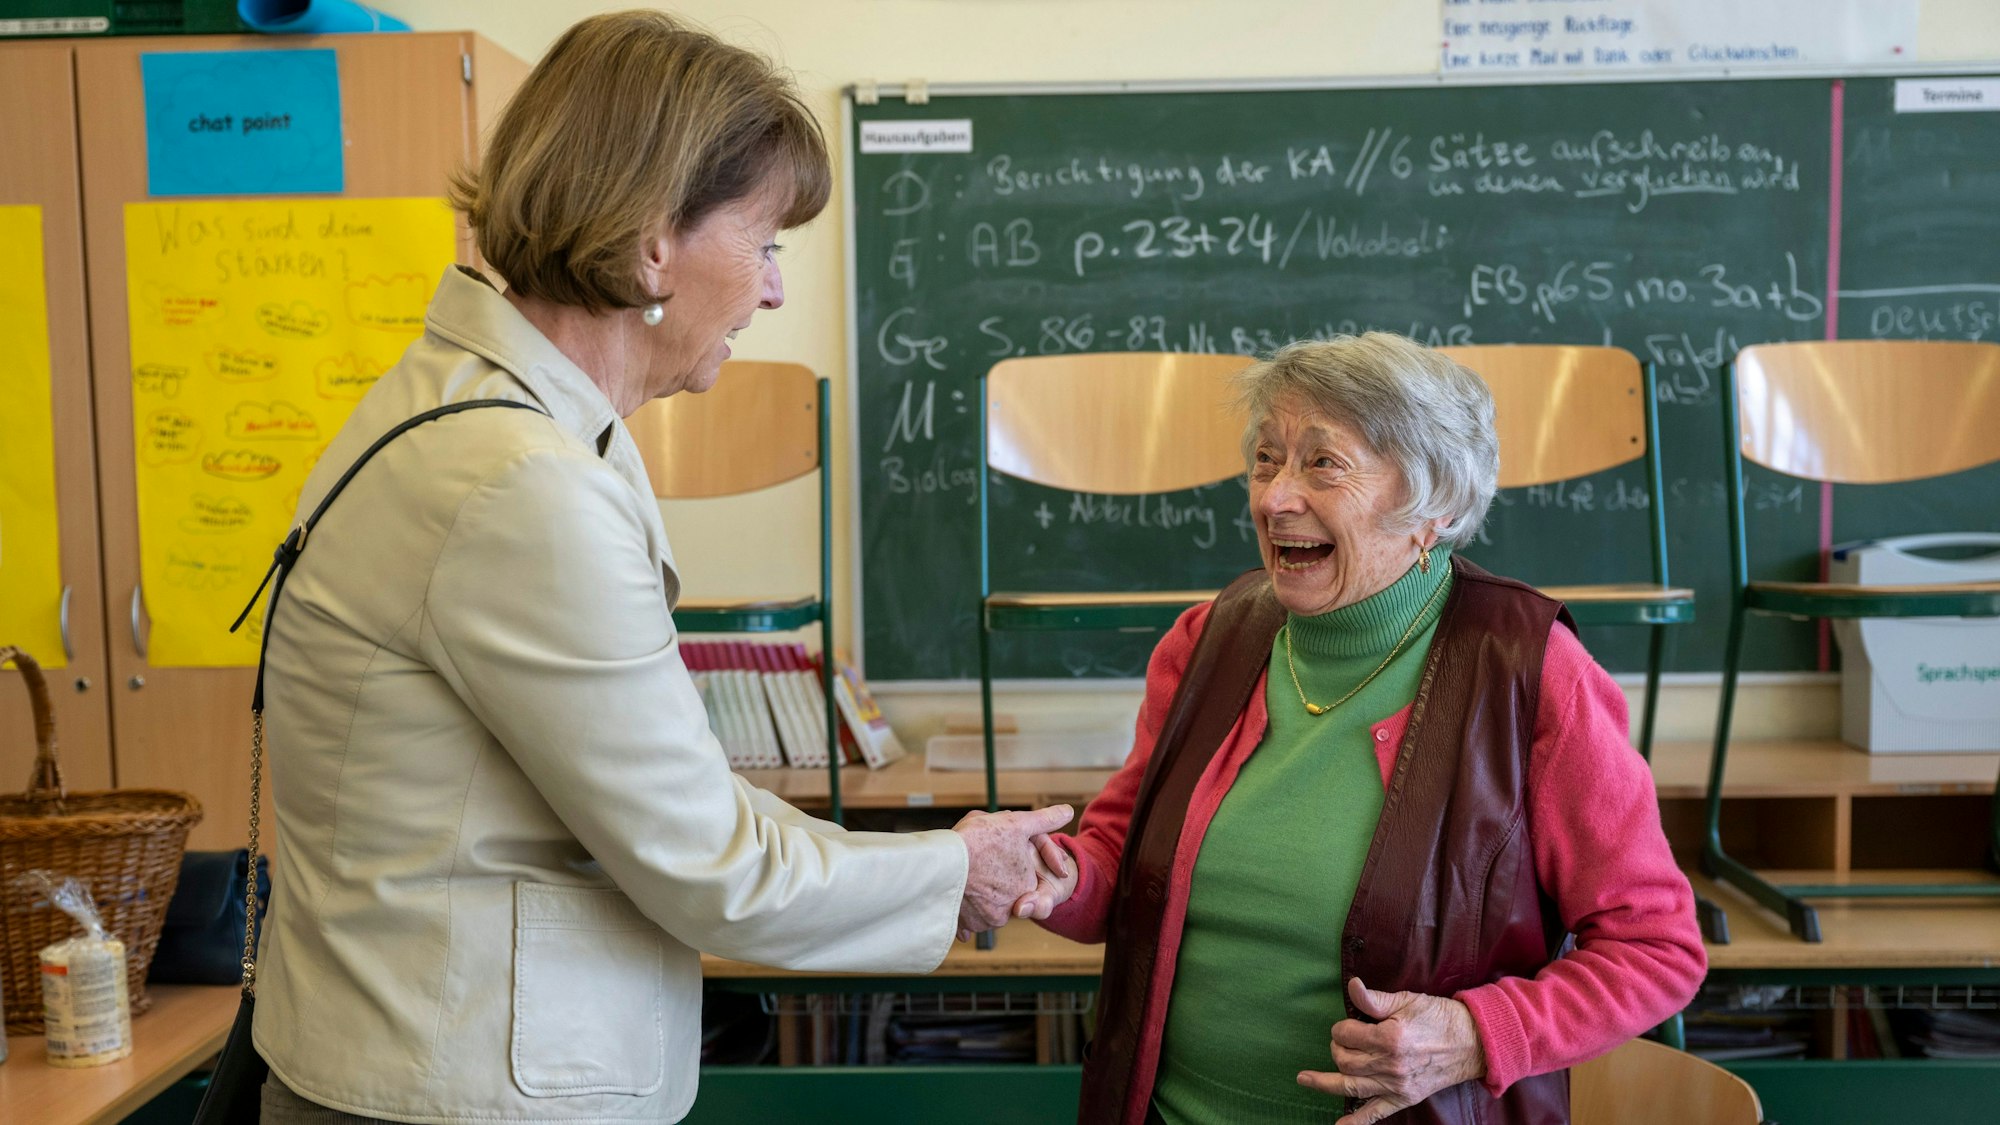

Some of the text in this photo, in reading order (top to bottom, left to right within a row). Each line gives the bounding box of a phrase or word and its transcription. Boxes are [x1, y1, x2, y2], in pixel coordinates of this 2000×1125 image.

[1922, 87, 1983, 103] Termine
[188, 112, 292, 137] chat point
[865, 129, 968, 147] Hausaufgaben
[986, 154, 1205, 200] Berichtigung
[1216, 155, 1271, 187] der
[1287, 145, 1335, 180] KA
[1427, 131, 1536, 172] Sätze
[1741, 160, 1800, 191] wird
[155, 206, 226, 255] Was
[970, 217, 1042, 267] AB
